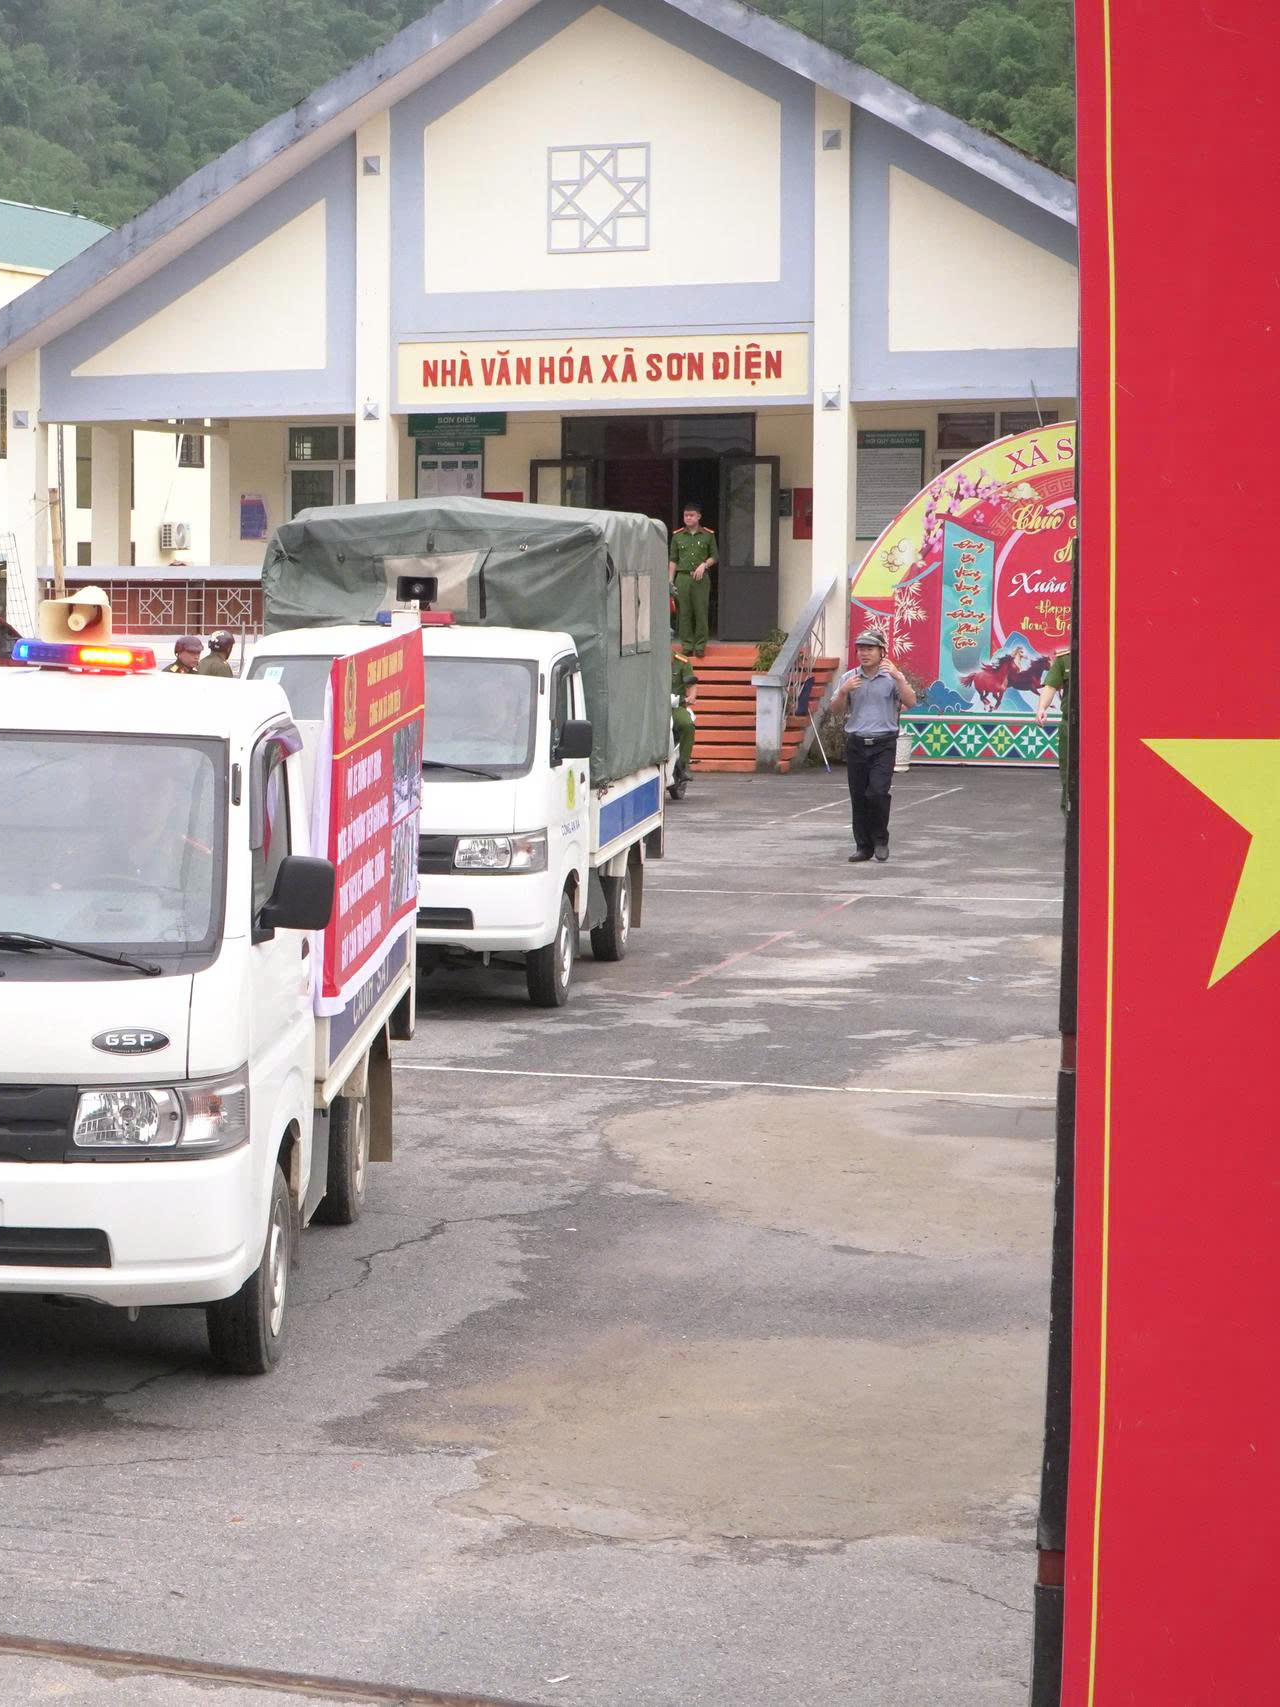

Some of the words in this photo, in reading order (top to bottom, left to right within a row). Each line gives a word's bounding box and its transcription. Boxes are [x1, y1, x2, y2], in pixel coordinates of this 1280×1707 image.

[422, 350, 473, 387] NHÀ
[481, 350, 531, 386] VĂN
[539, 347, 593, 384] HÓA
[601, 347, 637, 383] XÃ
[646, 352, 704, 382] SƠN
[1005, 439, 1050, 475] XÃ
[1056, 438, 1075, 460] S
[1008, 569, 1067, 597] Xuân
[1035, 600, 1072, 618] Happ
[105, 1033, 155, 1047] GSP
